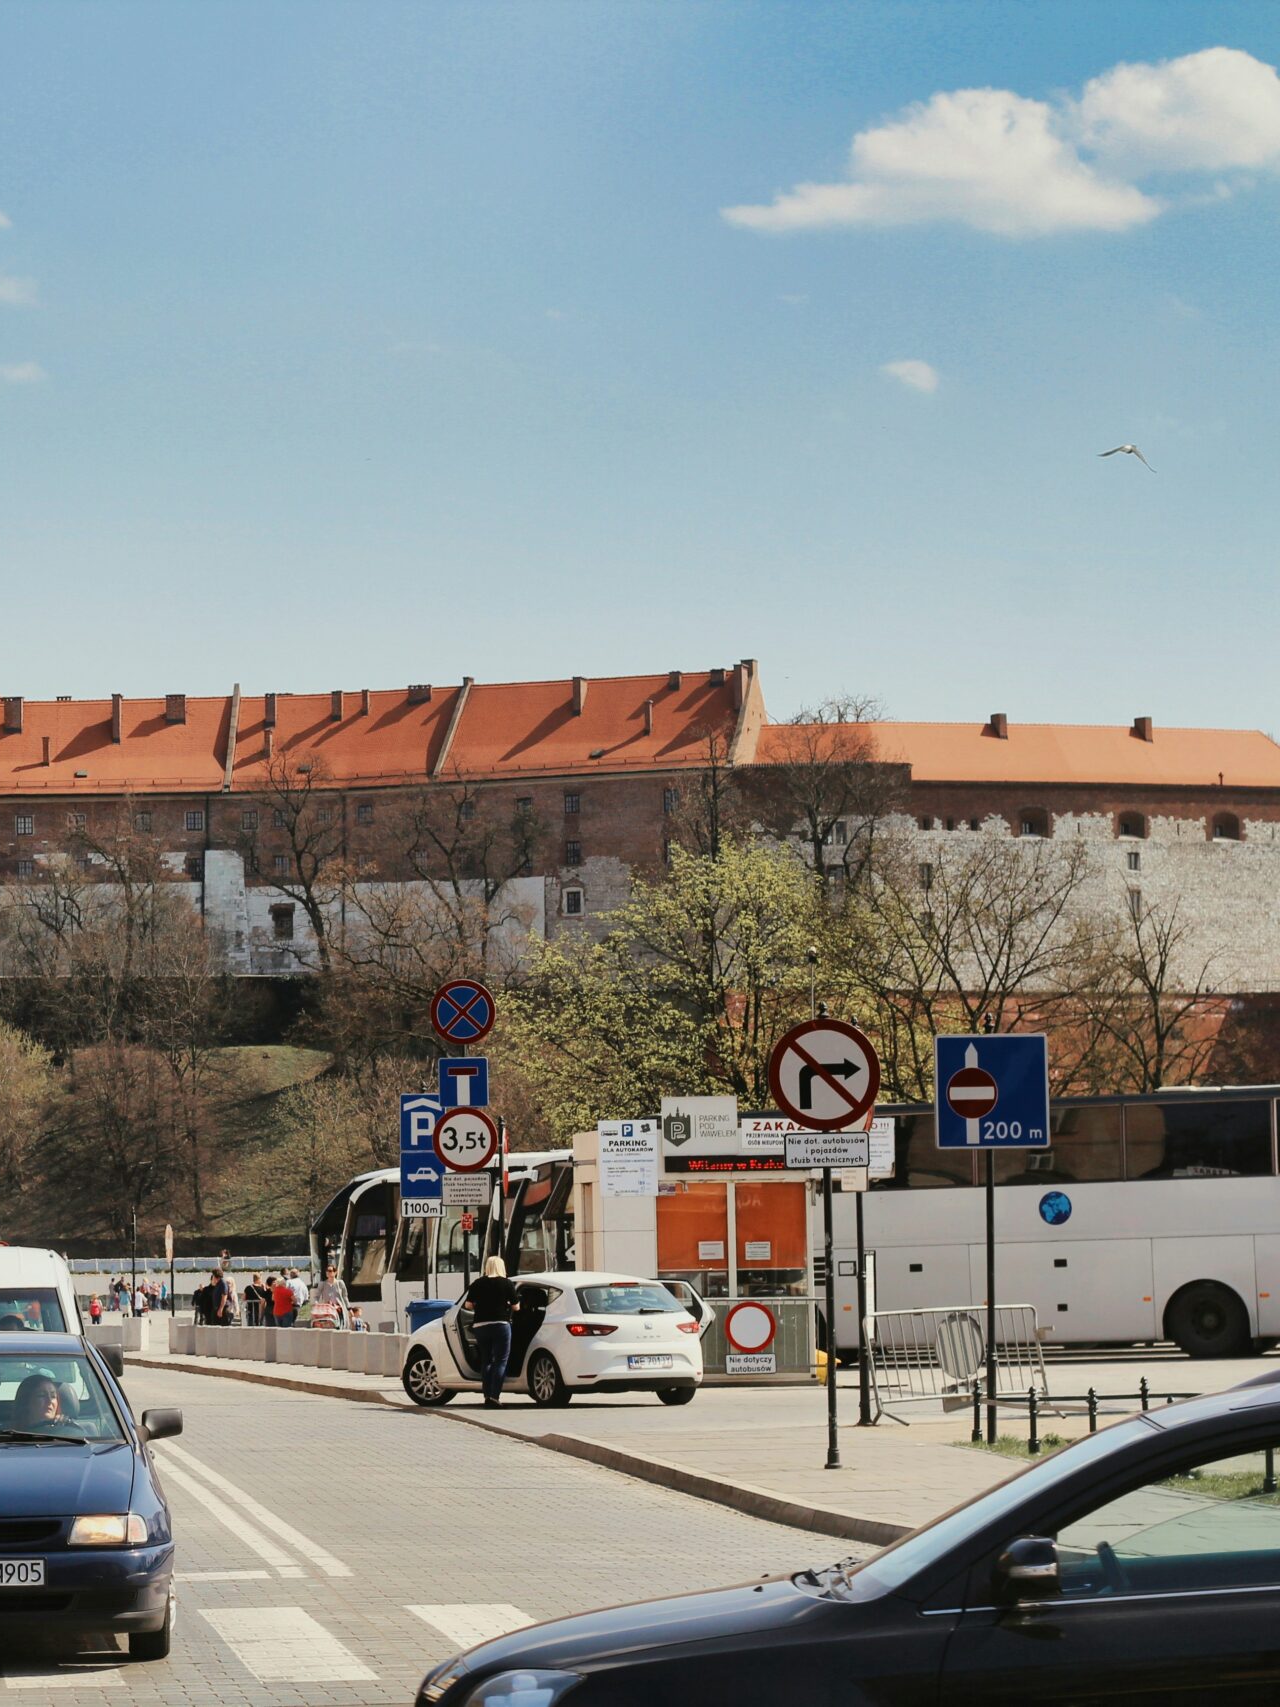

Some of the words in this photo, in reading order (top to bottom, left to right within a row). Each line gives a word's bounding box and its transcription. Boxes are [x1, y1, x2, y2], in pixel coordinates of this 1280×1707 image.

[983, 1121, 1022, 1139] 200
[1029, 1128, 1043, 1138] m
[442, 1126, 487, 1153] 3,5t
[822, 1136, 865, 1144] autobusów
[810, 1147, 849, 1155] pojazdów
[790, 1156, 811, 1164] służb
[813, 1155, 864, 1164] technicznych
[743, 1356, 773, 1364] dotyczy
